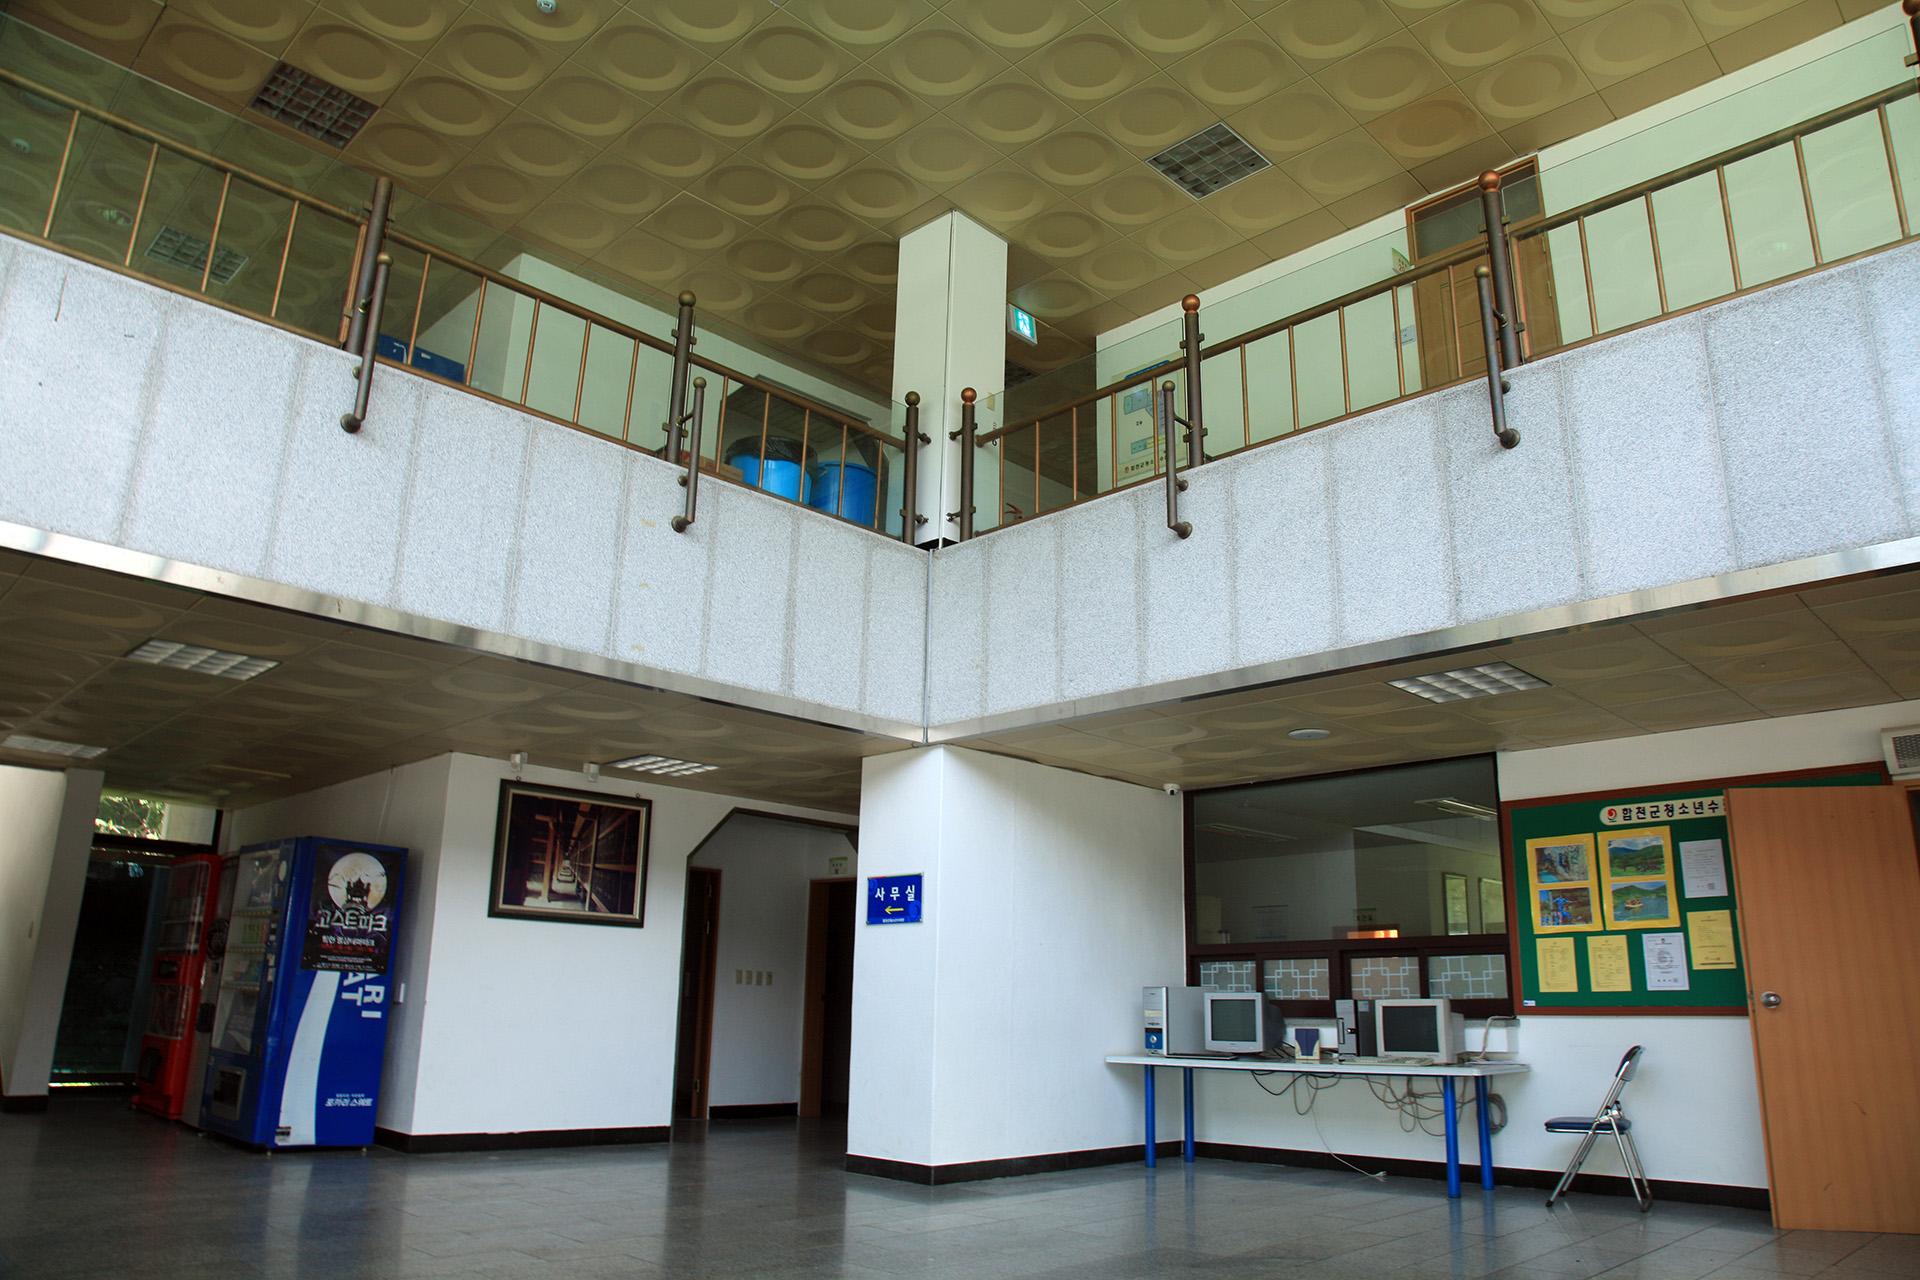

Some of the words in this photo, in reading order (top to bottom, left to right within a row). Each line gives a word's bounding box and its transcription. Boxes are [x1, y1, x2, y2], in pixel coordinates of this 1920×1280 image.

[1622, 799, 1726, 821] 합천군청소년수
[875, 885, 916, 902] 사무실
[315, 909, 388, 933] 고스트파크
